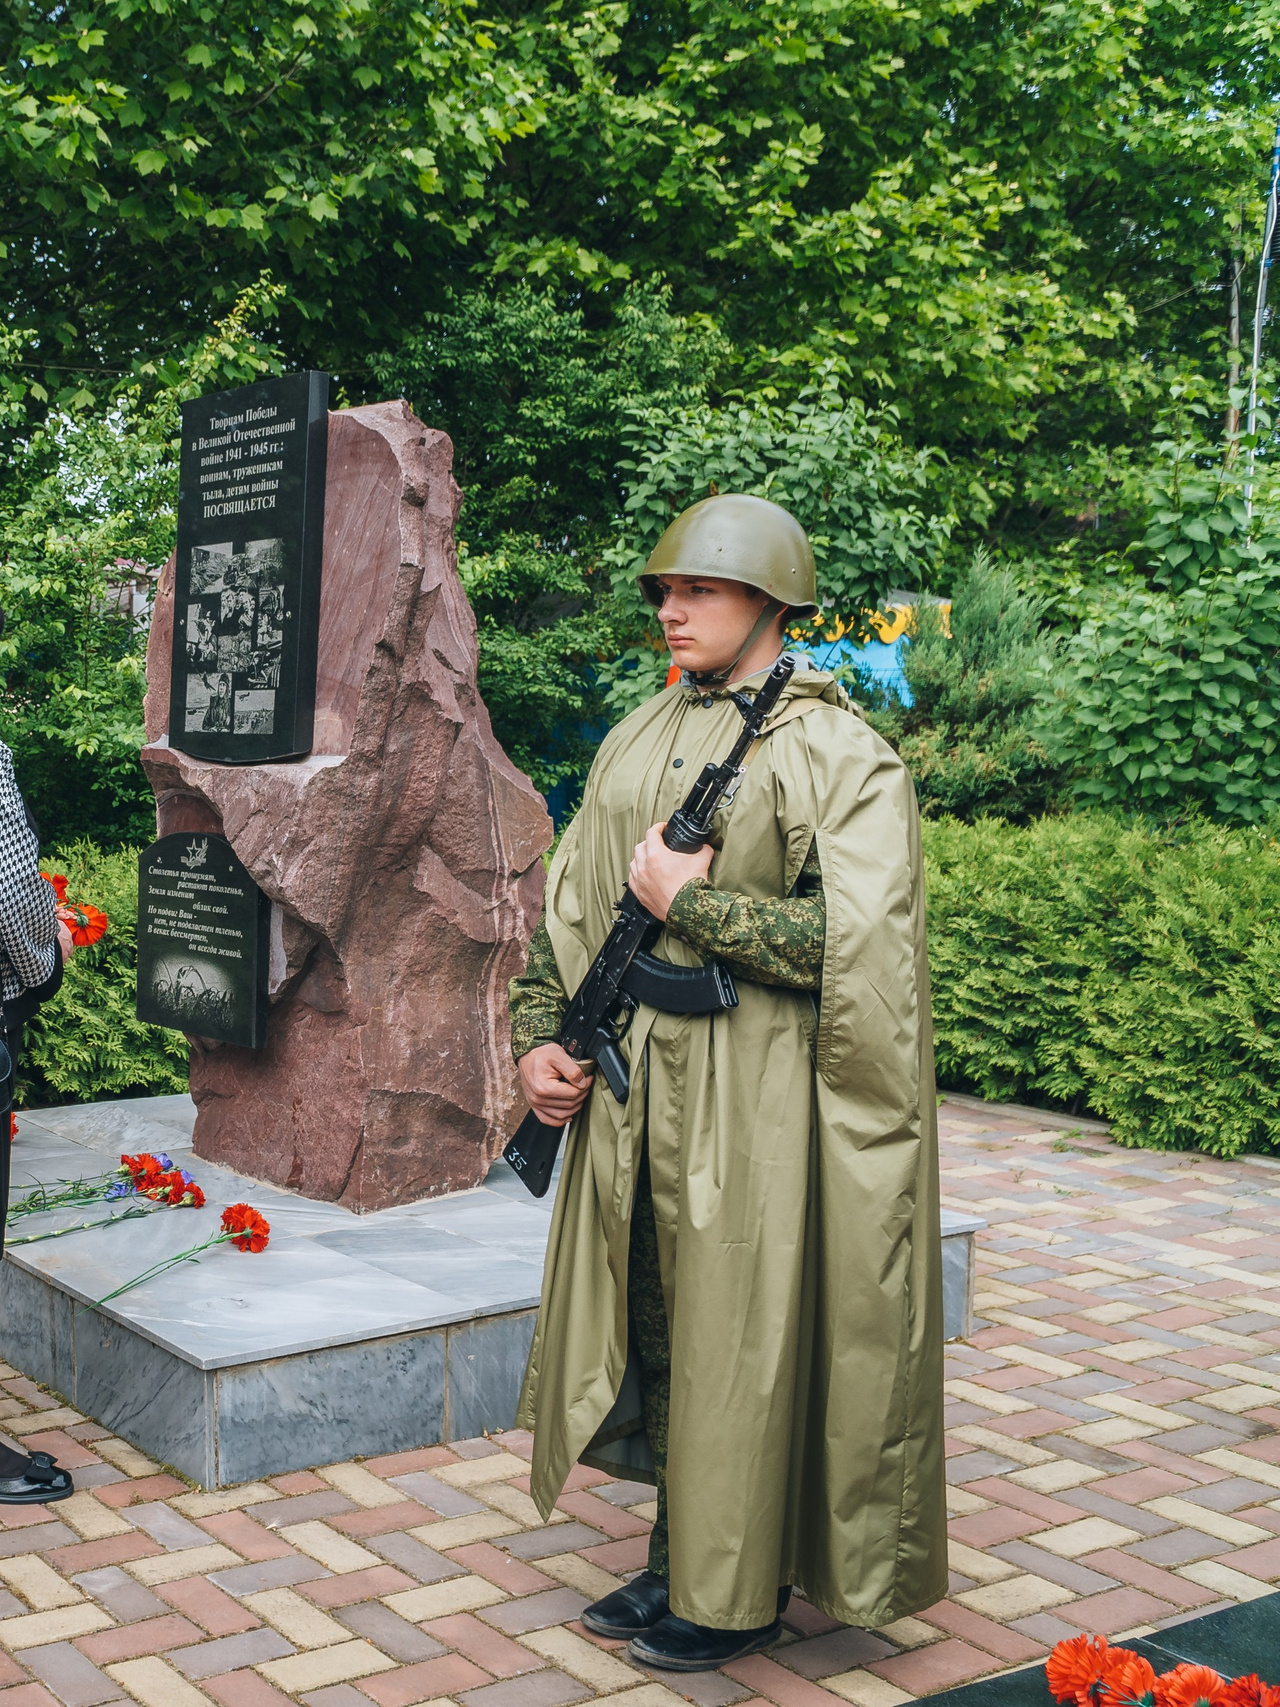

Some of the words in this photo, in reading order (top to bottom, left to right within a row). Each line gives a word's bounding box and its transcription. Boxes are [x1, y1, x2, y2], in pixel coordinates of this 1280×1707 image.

[209, 414, 244, 430] Творцам
[245, 406, 277, 422] Победы
[192, 442, 197, 452] в
[198, 432, 232, 450] Великой
[233, 418, 296, 442] Отечественной
[200, 453, 224, 467] войне
[225, 447, 242, 462] 1941
[250, 441, 268, 457] 1945
[200, 470, 231, 484] воинам,
[232, 460, 283, 481] труженикам
[202, 489, 225, 501] тыла,
[226, 484, 250, 498] детям
[251, 479, 279, 493] войны
[204, 495, 276, 518] ПОСВЯЩАЕТСЯ
[148, 865, 179, 877] Столетья
[180, 871, 216, 883] прошумят,
[148, 885, 166, 896] Земля
[166, 890, 195, 899] изменит
[177, 881, 208, 891] растают
[208, 885, 244, 896] поколенья,
[147, 905, 157, 914] Но
[157, 907, 178, 917] подвиг
[178, 909, 193, 919] Ваш
[192, 901, 212, 912] облик
[212, 905, 229, 914] свой.
[147, 924, 153, 933] В
[153, 928, 170, 936] веках
[170, 928, 209, 943] бессмертен,
[154, 917, 168, 927] нет,
[169, 919, 177, 927] не
[177, 920, 214, 933] подвластен
[214, 927, 243, 938] тленью,
[188, 943, 196, 951] он
[197, 945, 217, 954] всегда
[218, 948, 243, 959] живой.
[508, 1147, 527, 1171] 35
